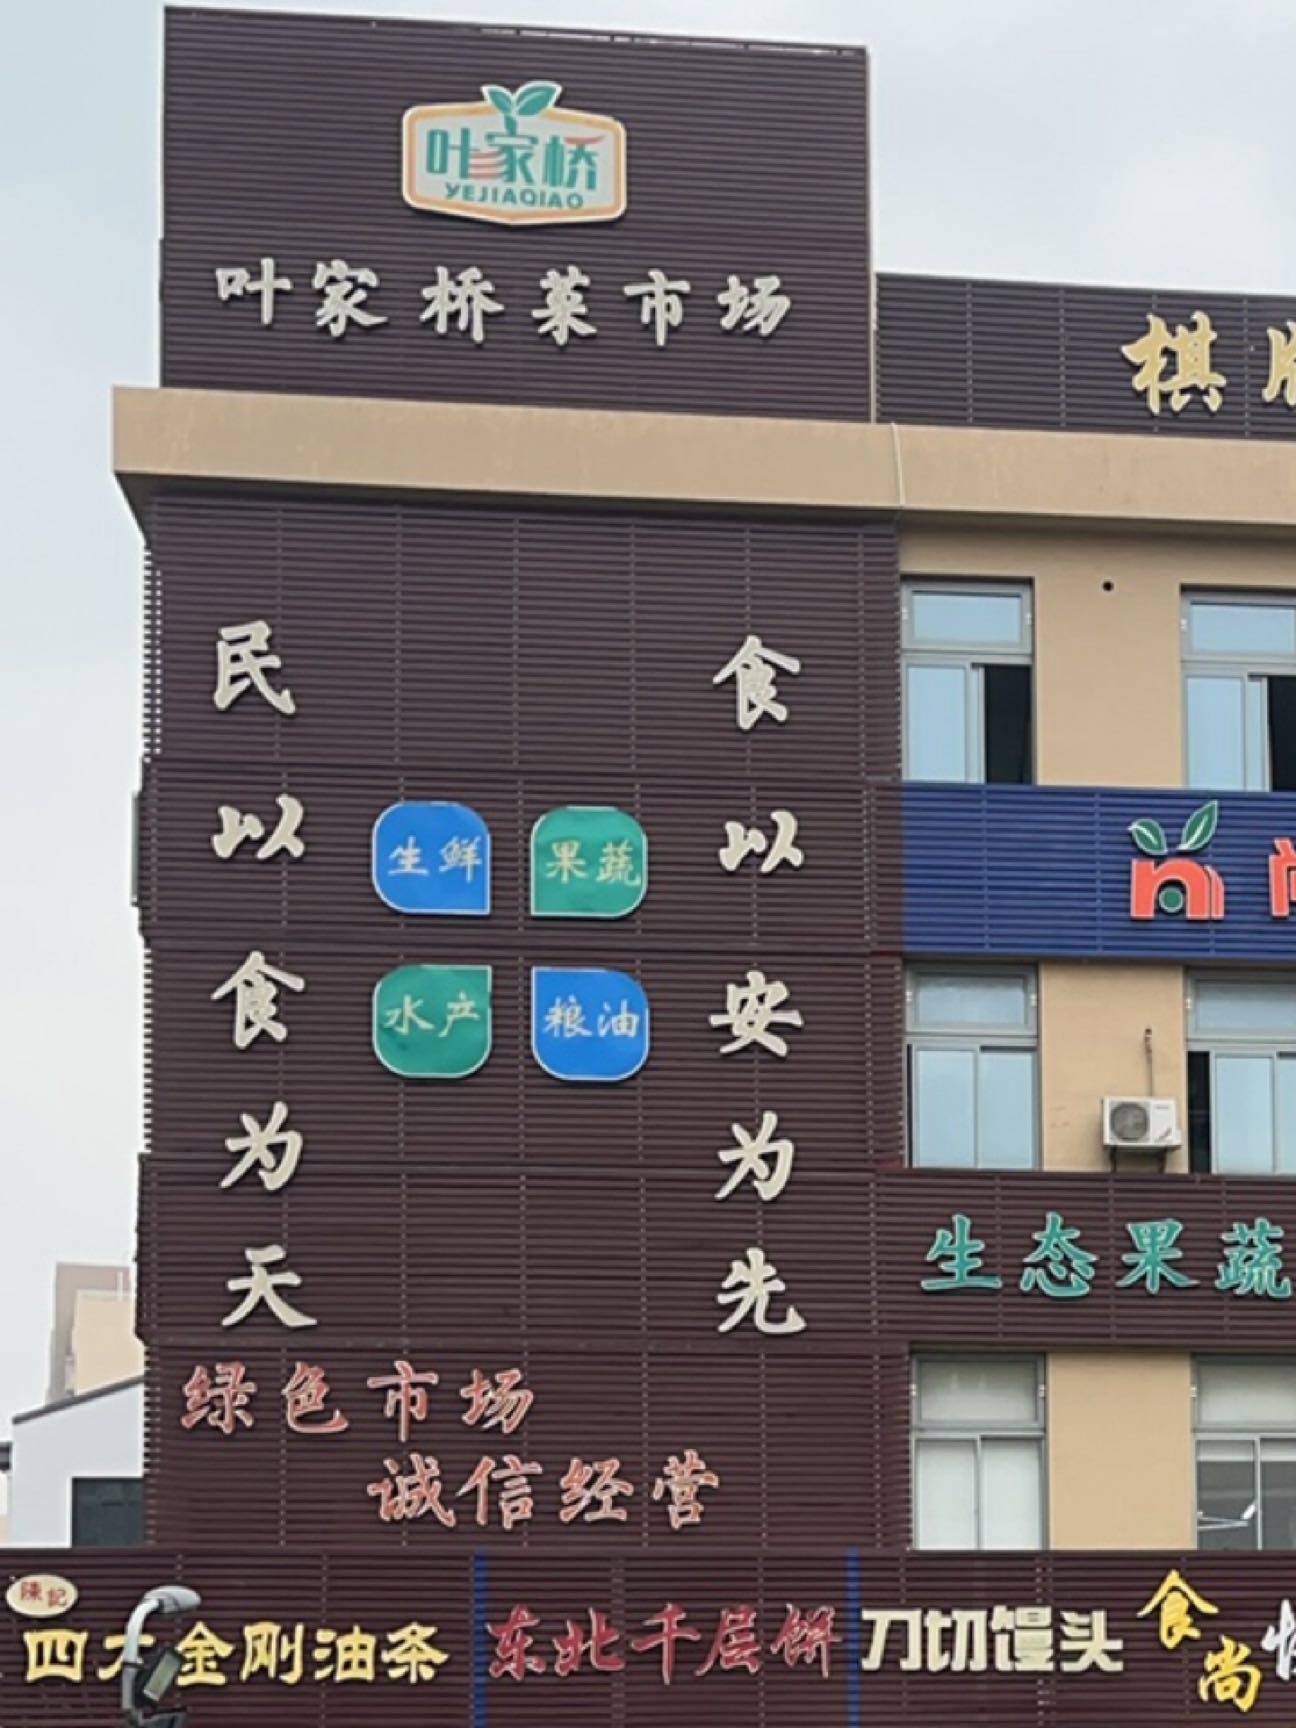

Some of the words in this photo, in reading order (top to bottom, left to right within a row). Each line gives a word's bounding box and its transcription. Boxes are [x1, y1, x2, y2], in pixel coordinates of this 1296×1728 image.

[426, 117, 606, 191] 叶家桥
[445, 182, 584, 210] YEJIAQIAO
[214, 257, 793, 346] 叶家桥菜市场
[388, 836, 482, 883] 生鲜
[544, 839, 642, 888] 果蔬
[210, 620, 317, 1328] 民以食为天
[382, 991, 481, 1038] 水产
[708, 634, 806, 1335] 食以安为先
[544, 996, 640, 1040] 粮油
[919, 1210, 1294, 1300] 生态果蔬
[180, 1360, 535, 1442] 绿色市场
[366, 1449, 720, 1531] 诚信经营
[484, 1602, 845, 1685] 东北千层饼
[859, 1605, 1125, 1674] 刀切馒头
[1137, 1570, 1264, 1712] 食尚
